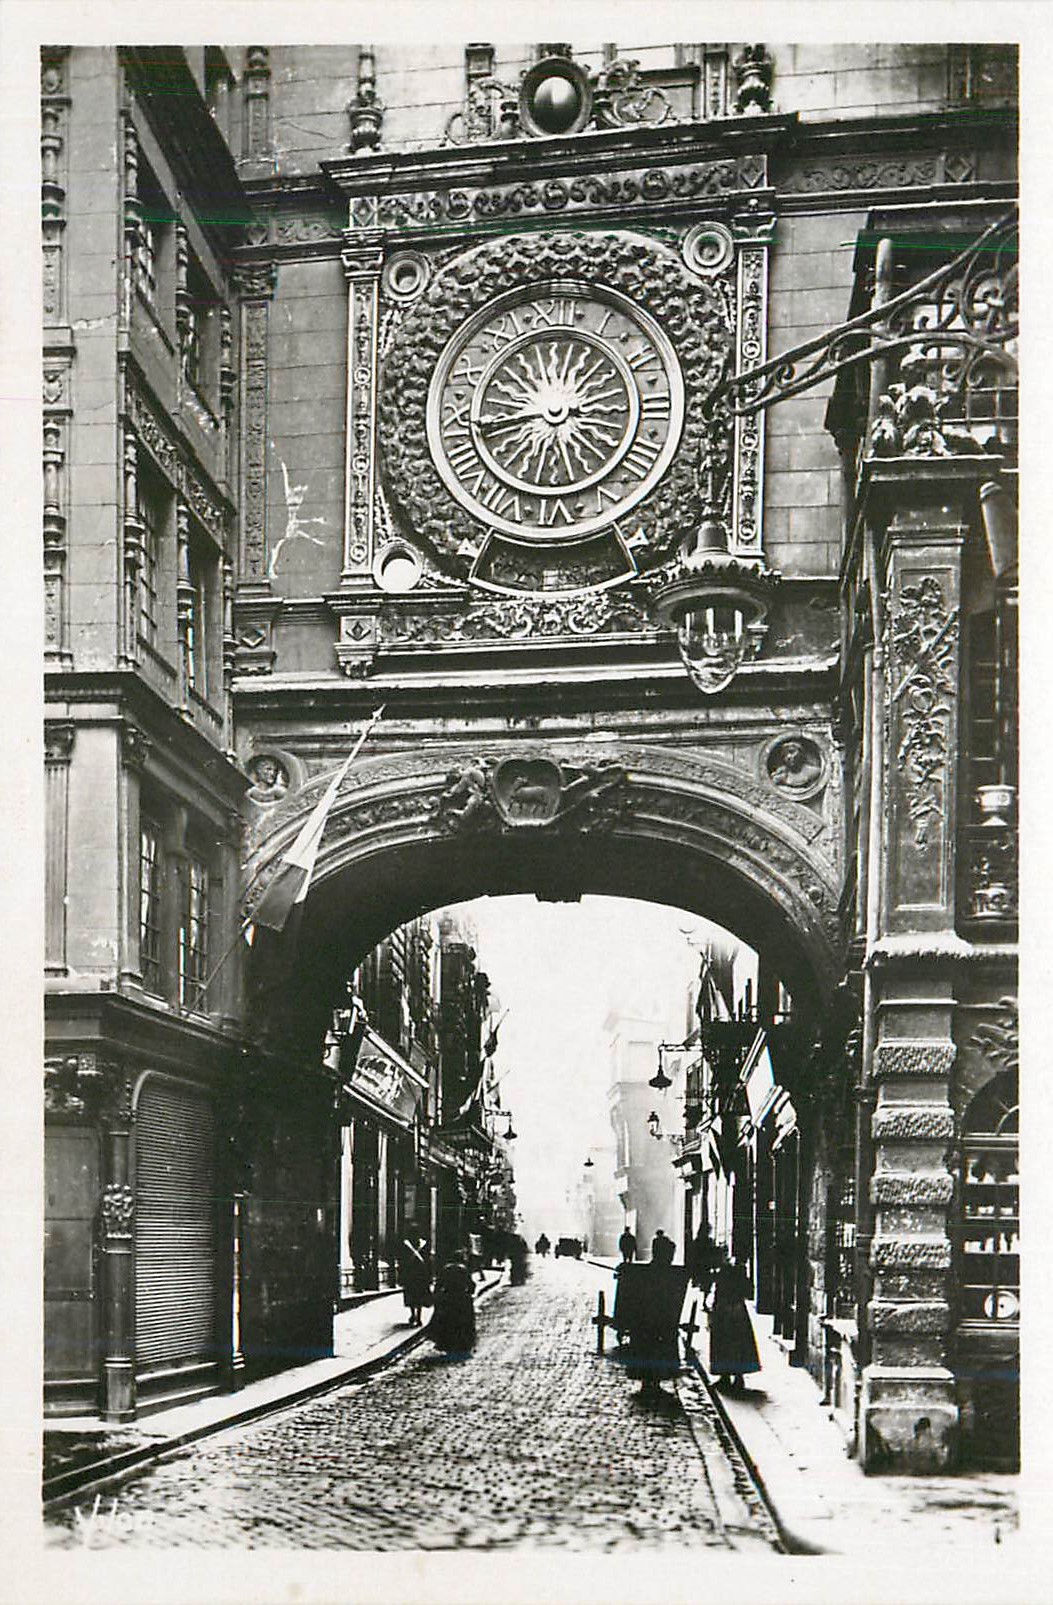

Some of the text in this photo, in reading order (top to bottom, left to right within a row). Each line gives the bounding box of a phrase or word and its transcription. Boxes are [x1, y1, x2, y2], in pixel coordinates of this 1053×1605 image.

[531, 299, 576, 329] XII
[484, 312, 522, 352] XI
[453, 355, 484, 386] X
[626, 346, 657, 370] II
[443, 403, 471, 438] IX
[641, 392, 670, 420] III
[446, 442, 486, 495] VIII
[622, 438, 661, 479] IIII
[481, 484, 523, 522] VII
[537, 498, 575, 526] VI
[596, 485, 622, 514] V
